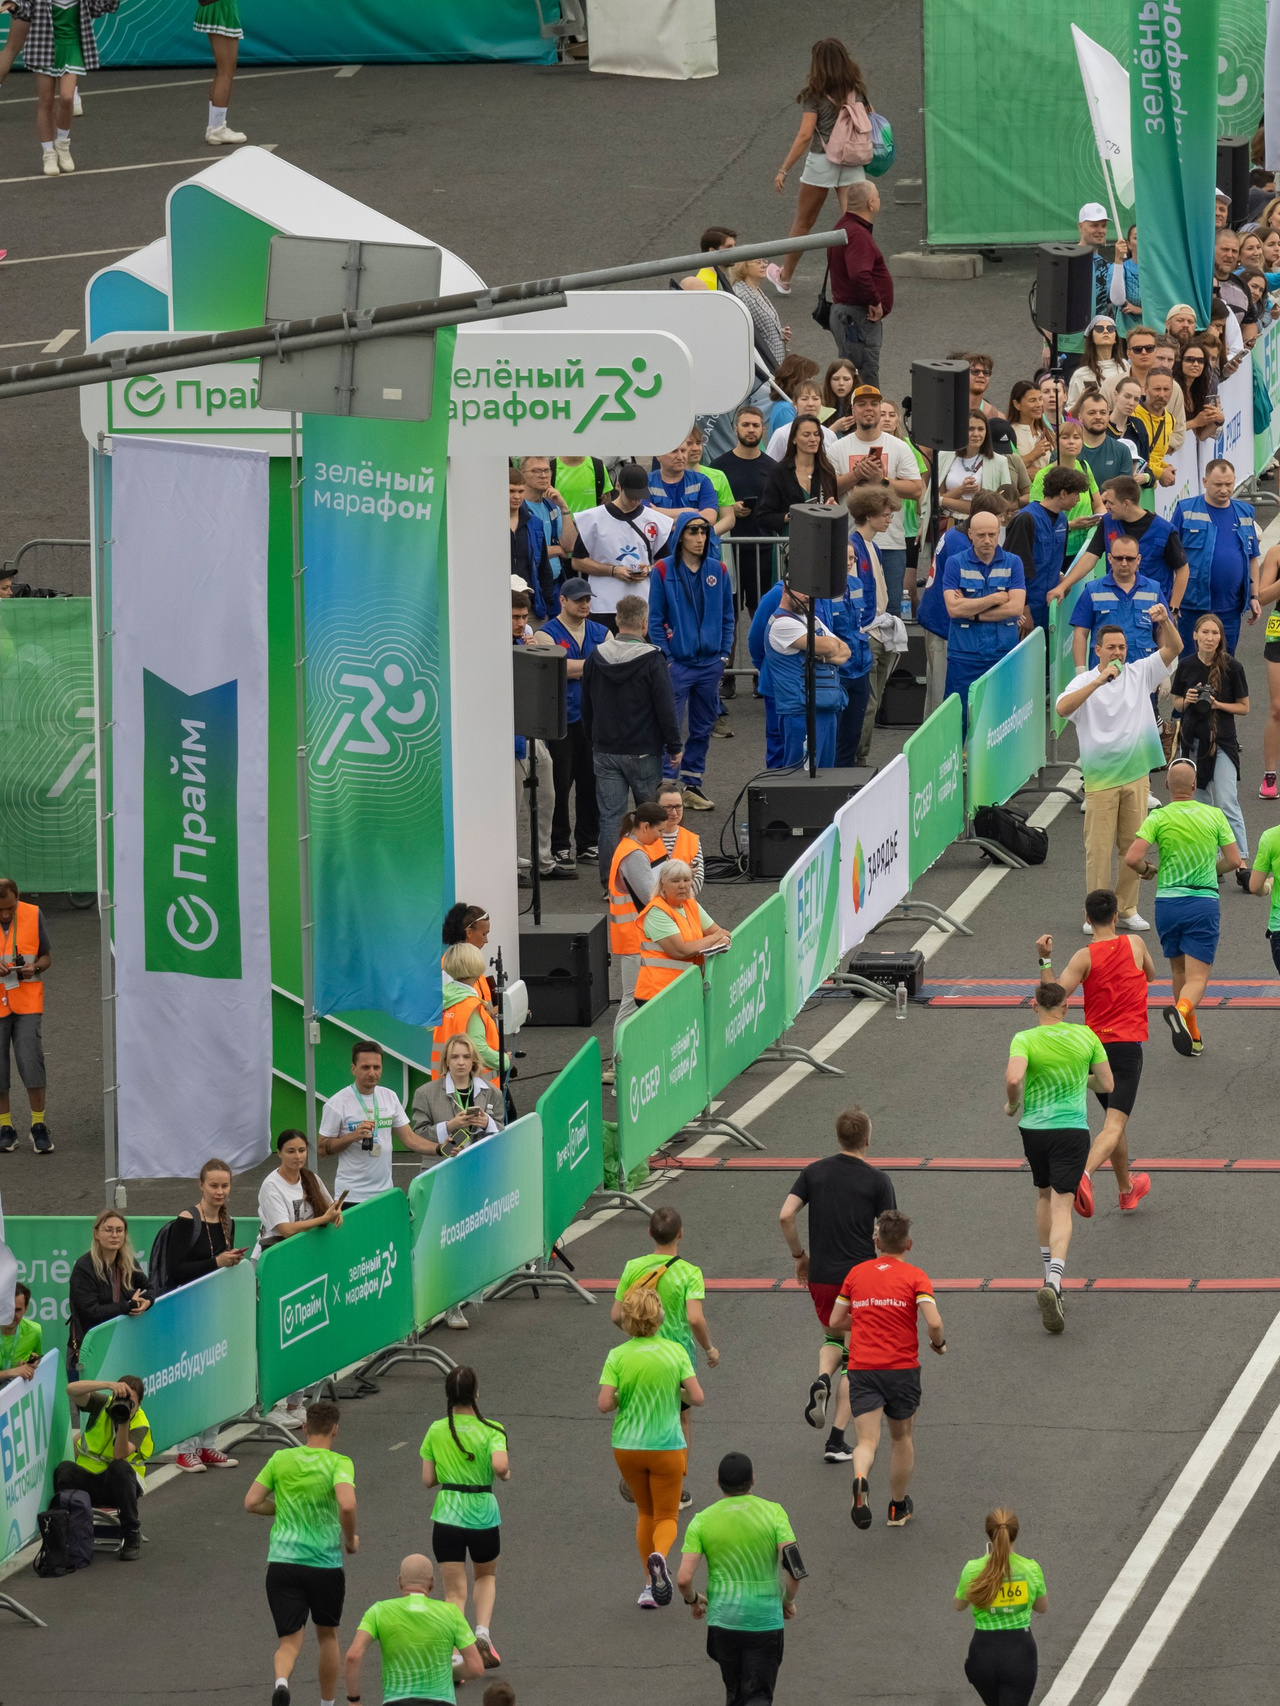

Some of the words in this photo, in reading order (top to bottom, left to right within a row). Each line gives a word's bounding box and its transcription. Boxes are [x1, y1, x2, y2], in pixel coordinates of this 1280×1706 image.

[453, 358, 585, 389] елёный
[176, 378, 259, 416] Пра
[449, 393, 572, 427] арафон
[314, 457, 435, 495] зелёный
[313, 491, 432, 522] марафон
[170, 718, 216, 883] Прайм
[640, 1064, 660, 1107] СБЕР
[440, 1188, 520, 1250] #создаваябудущее
[349, 1249, 381, 1282] зелёный
[295, 1294, 322, 1326] Прайм
[345, 1276, 379, 1306] марафон
[143, 1339, 228, 1398] здаваябудущее
[0, 1382, 48, 1484] БЕГИ
[5, 1457, 46, 1511] НАСТОЯЩИМ
[999, 1585, 1022, 1599] 166
